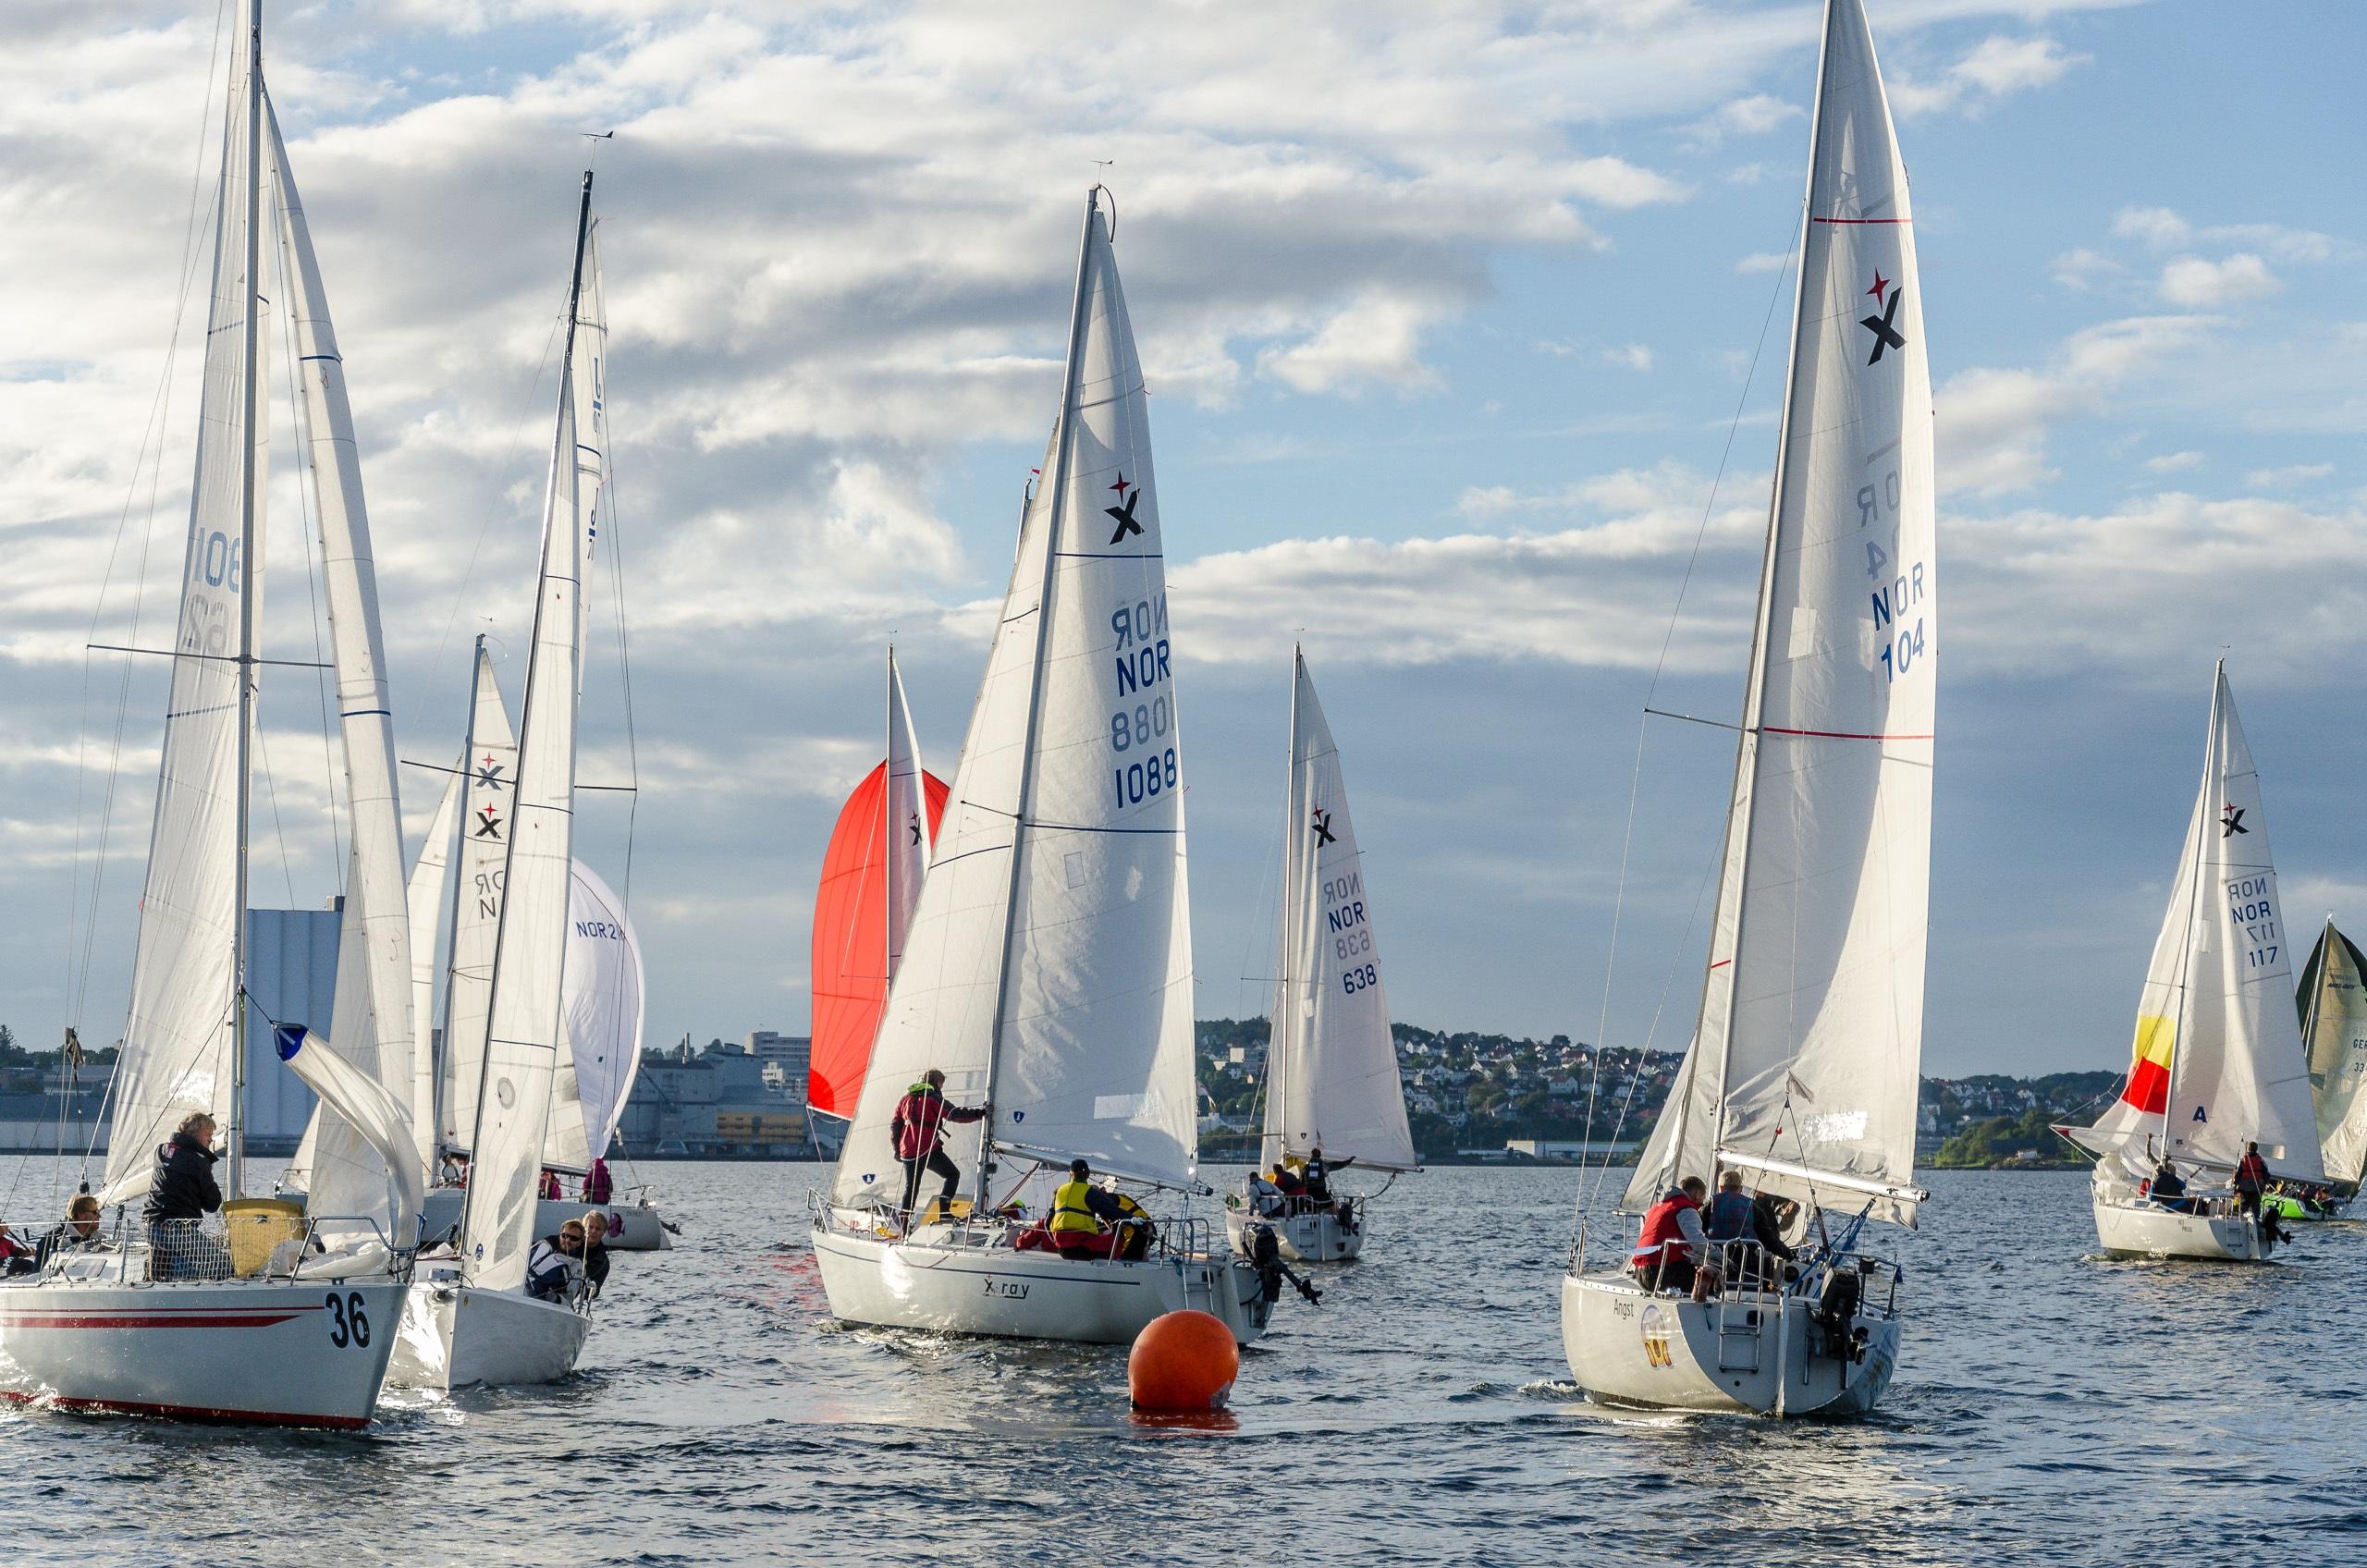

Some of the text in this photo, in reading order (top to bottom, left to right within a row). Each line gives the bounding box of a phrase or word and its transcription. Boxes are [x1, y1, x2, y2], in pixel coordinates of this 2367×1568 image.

[1872, 562, 1924, 631] NOR
[1881, 617, 1925, 683] 104
[1116, 639, 1171, 696] NOR
[1115, 747, 1176, 808] 1088
[1329, 900, 1366, 933] NOR
[2232, 900, 2271, 924] NOR
[2249, 946, 2278, 967] 117
[1343, 963, 1377, 995] 638
[2192, 1106, 2207, 1123] A
[325, 1292, 371, 1349] 36
[1613, 1299, 1634, 1320] Angst
